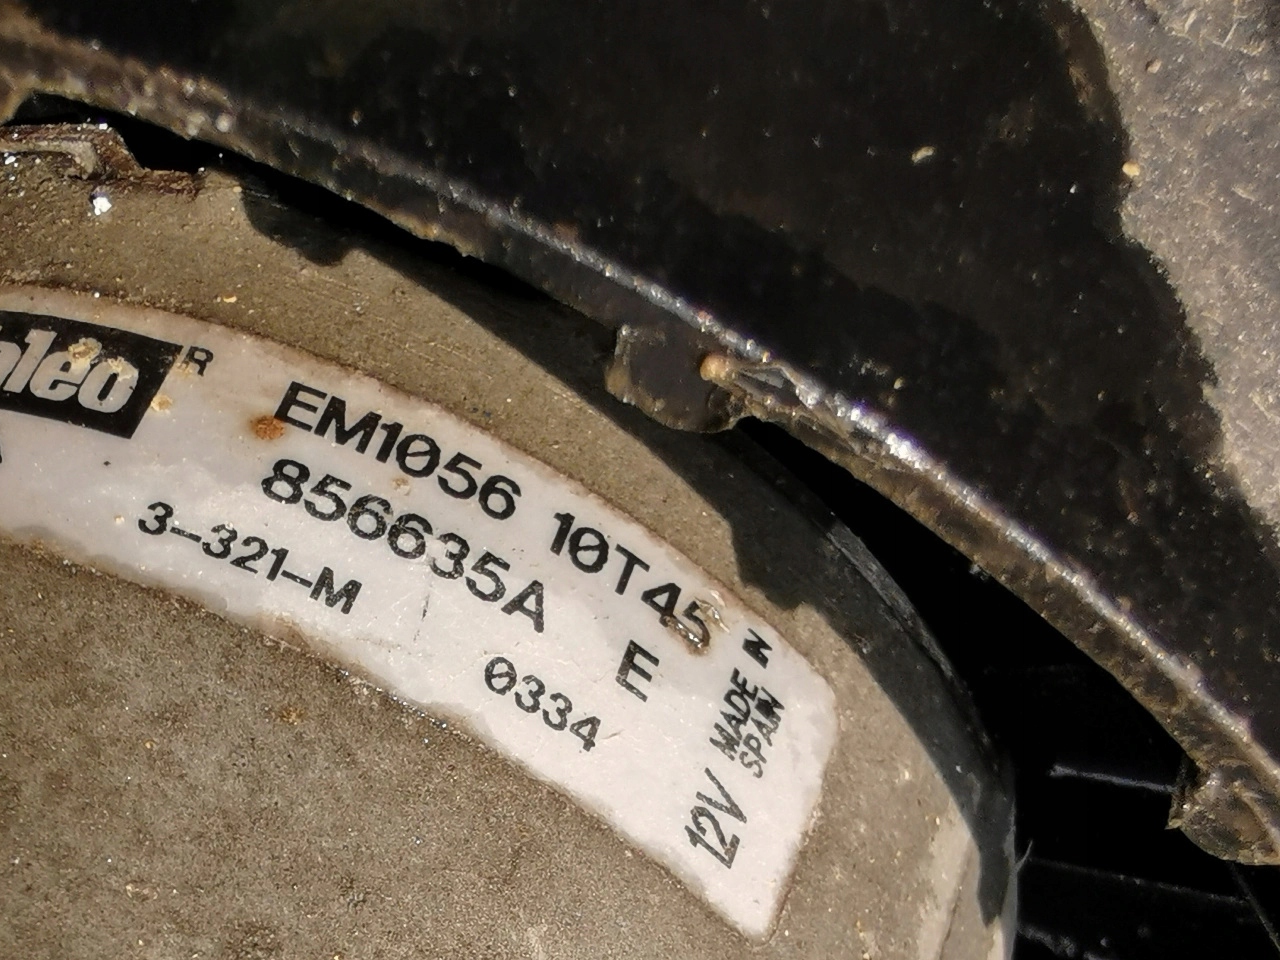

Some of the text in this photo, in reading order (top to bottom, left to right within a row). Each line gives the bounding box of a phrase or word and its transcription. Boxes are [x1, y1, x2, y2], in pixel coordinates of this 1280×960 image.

[138, 501, 363, 615] 3-321-M
[261, 458, 545, 633] 856635A
[273, 381, 718, 652] EM1056 10T45
[484, 656, 602, 752] 0334
[615, 639, 660, 702] E
[710, 667, 759, 761] MADE
[740, 686, 785, 778] SPAIN
[684, 768, 747, 869] 12V
